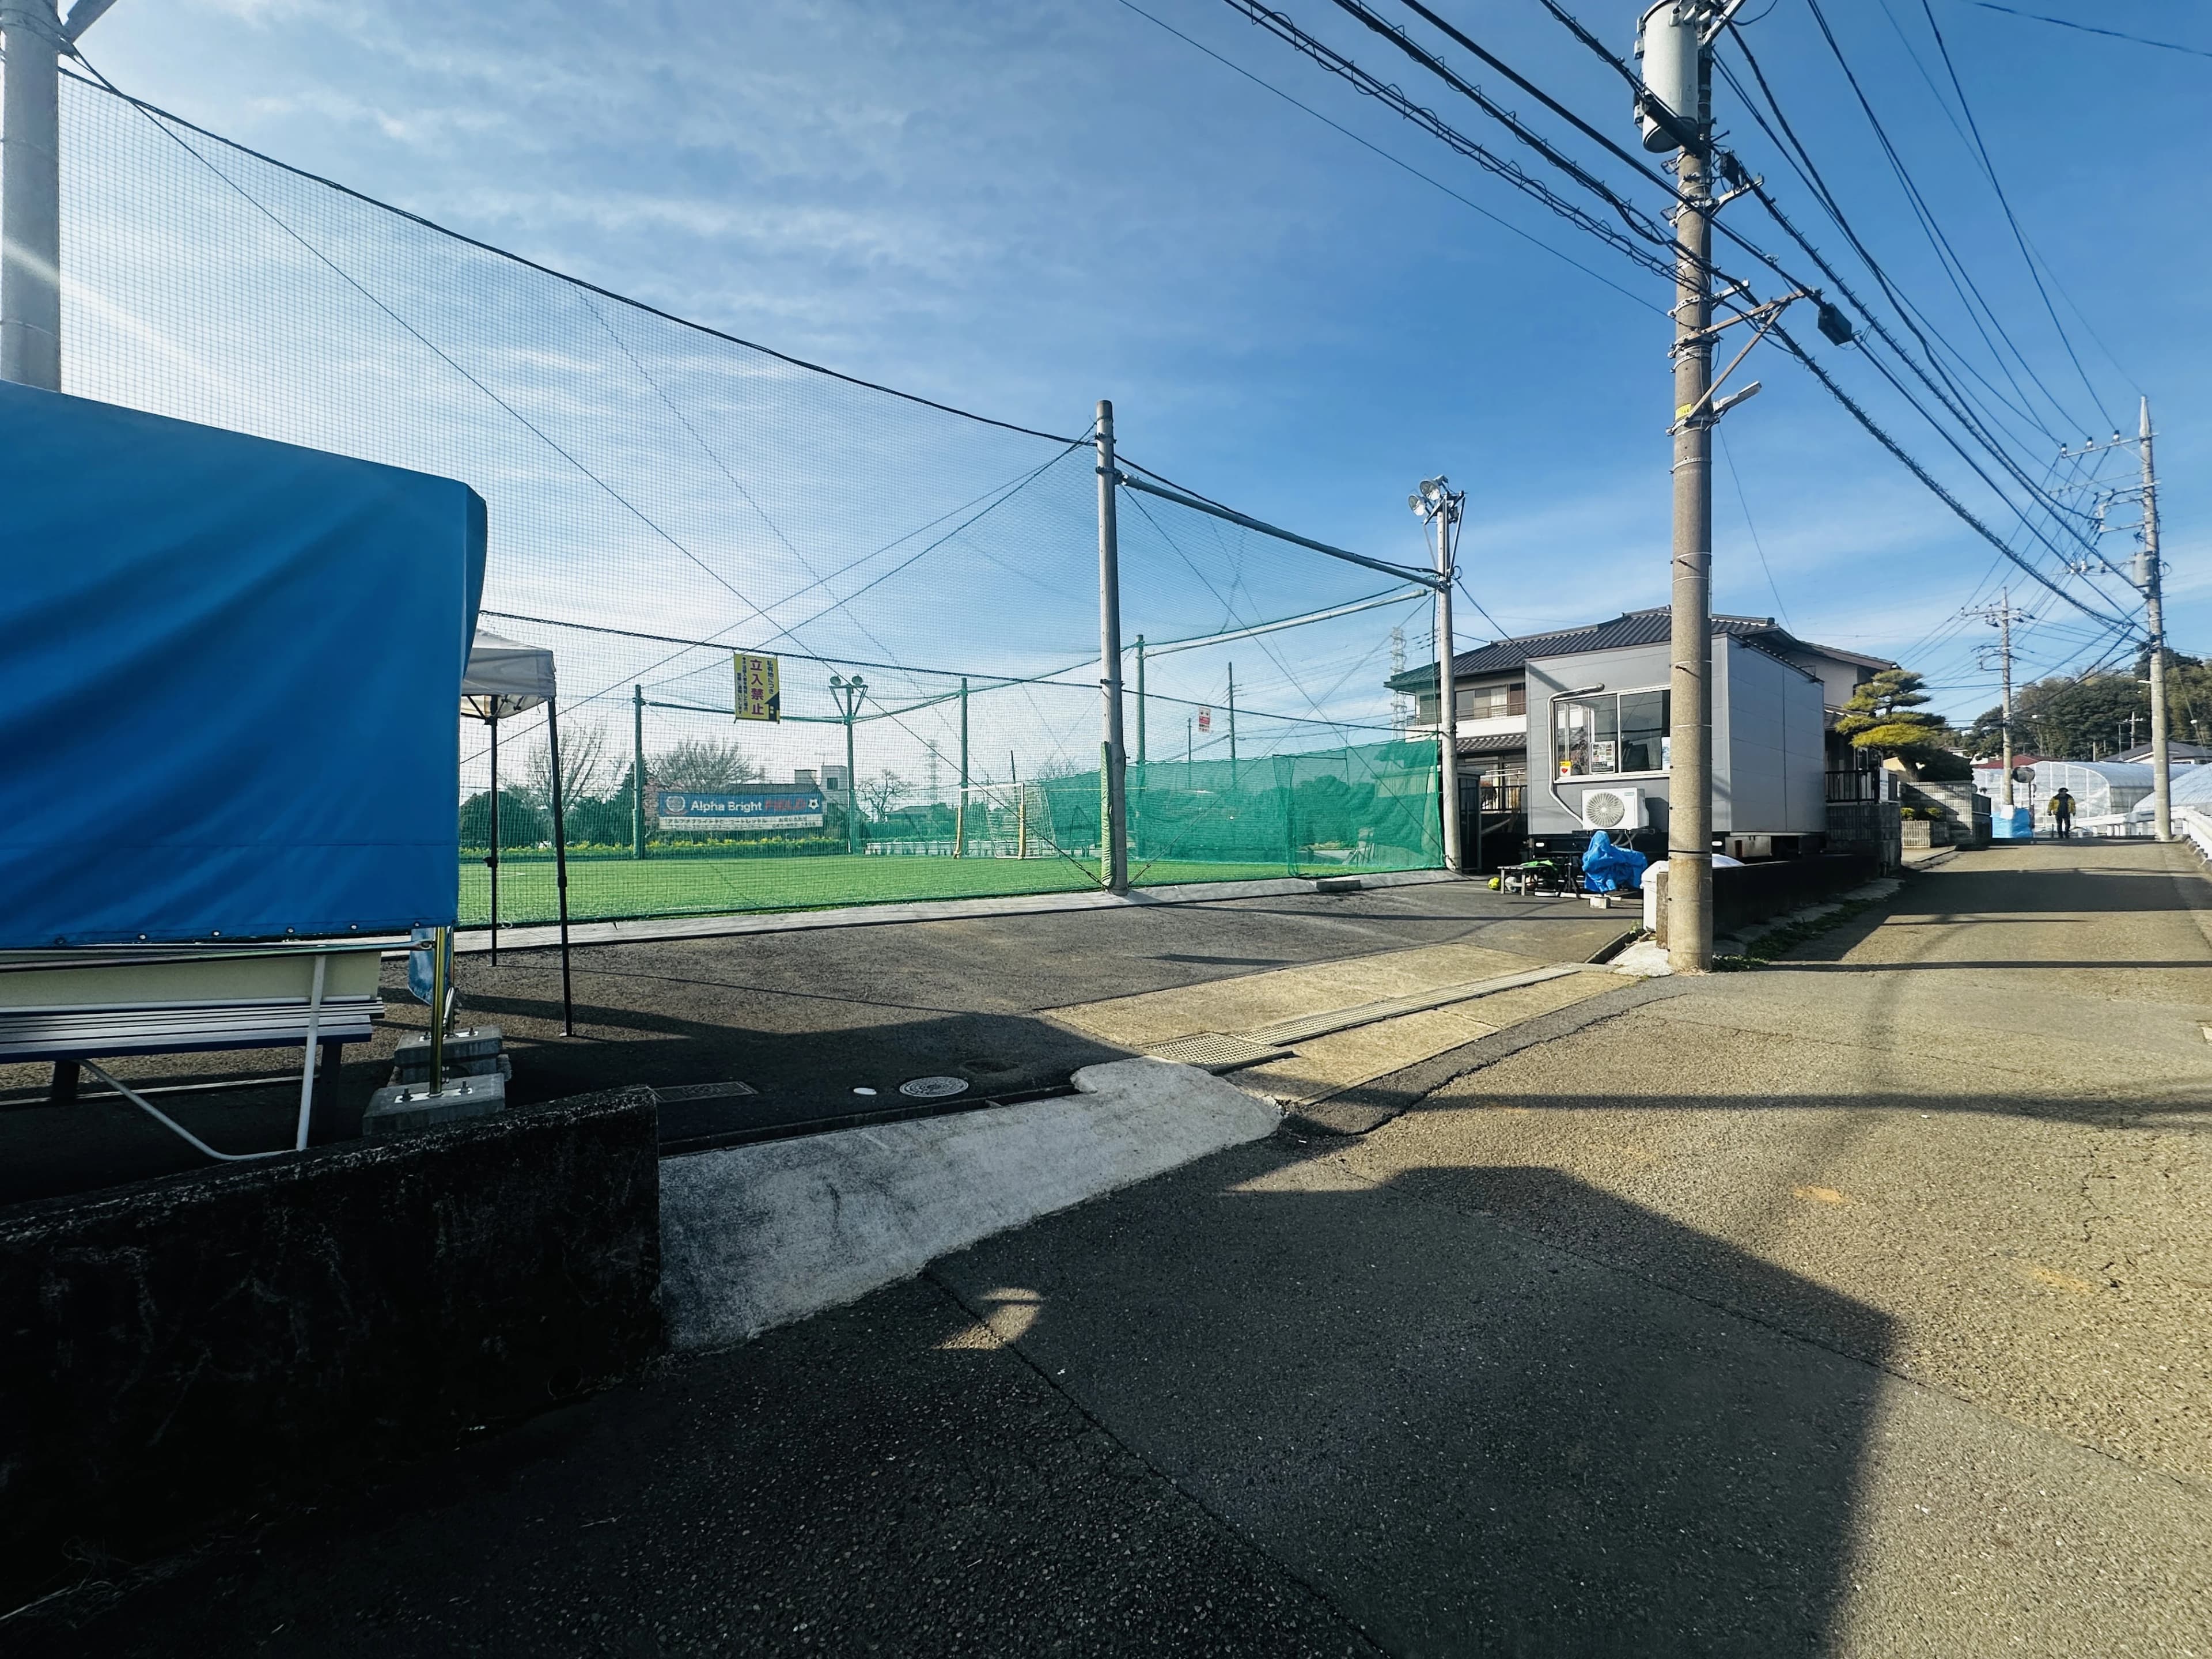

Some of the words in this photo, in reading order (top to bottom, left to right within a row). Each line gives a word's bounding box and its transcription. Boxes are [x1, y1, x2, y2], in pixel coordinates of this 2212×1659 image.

[750, 659, 764, 715] 立入禁止
[691, 800, 725, 813] Alpha
[728, 801, 762, 813] Bright
